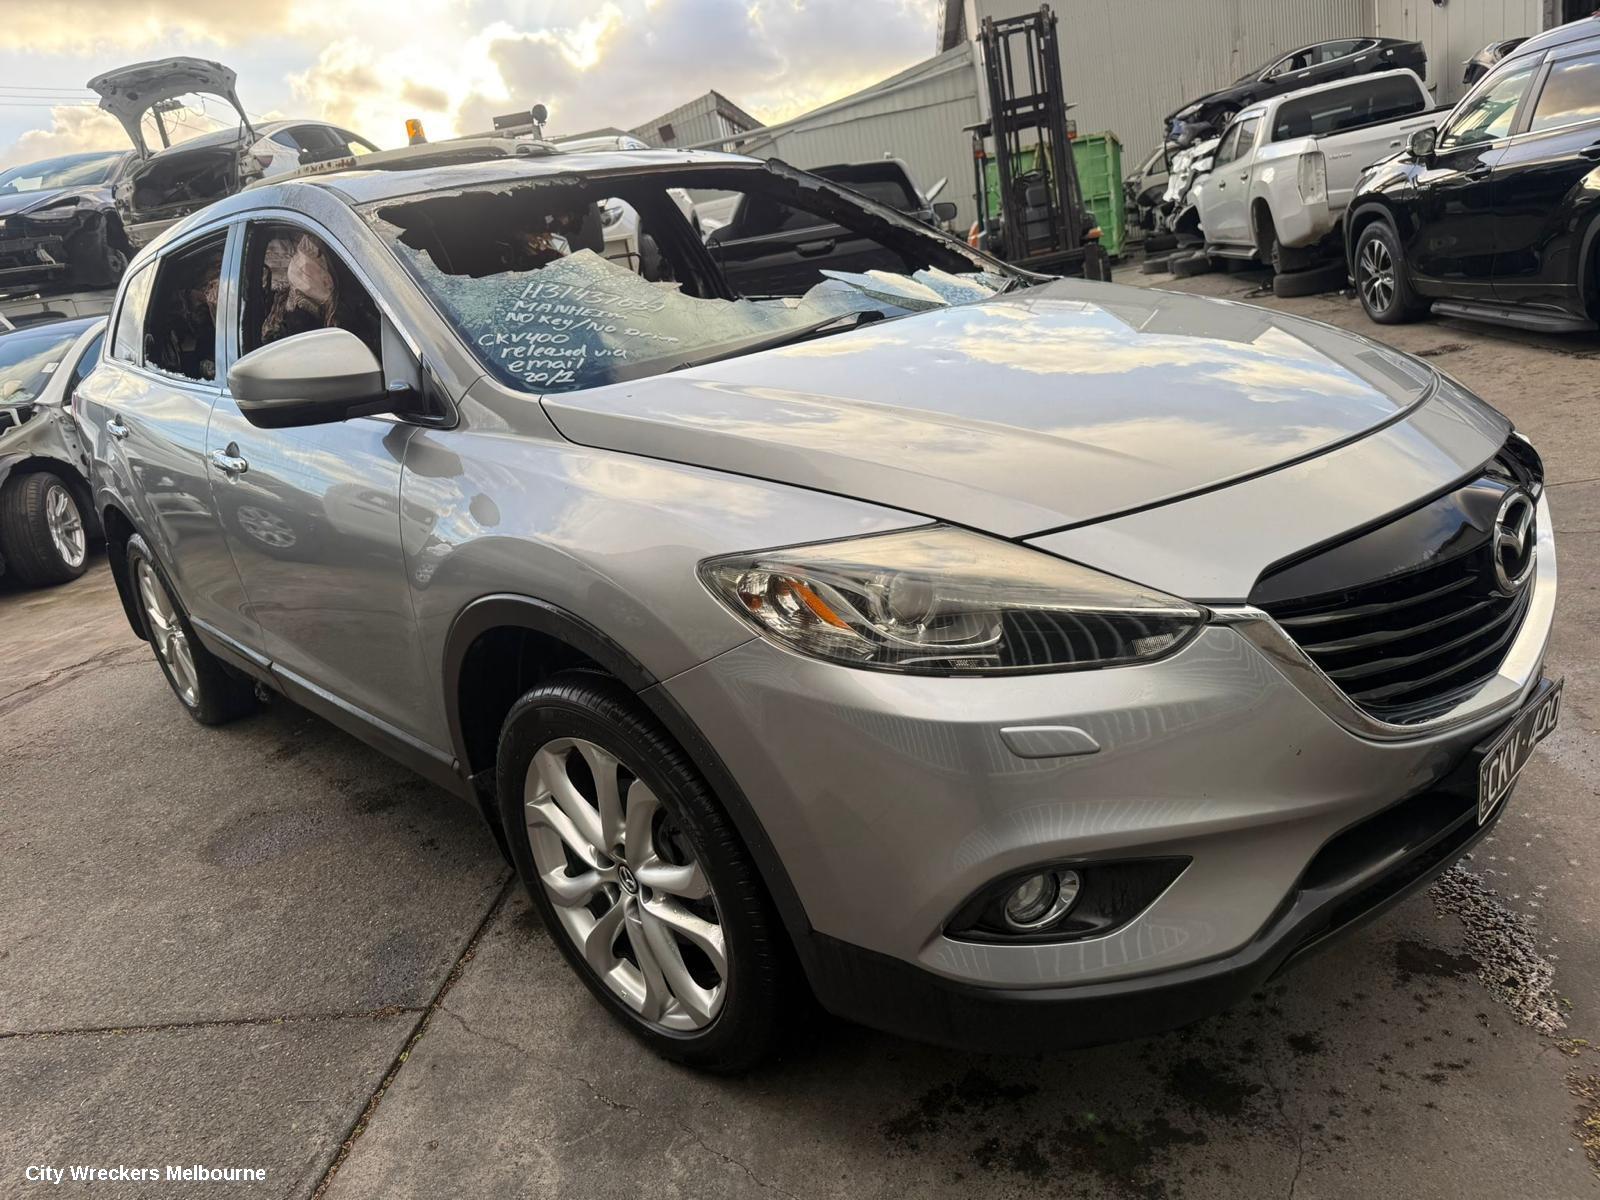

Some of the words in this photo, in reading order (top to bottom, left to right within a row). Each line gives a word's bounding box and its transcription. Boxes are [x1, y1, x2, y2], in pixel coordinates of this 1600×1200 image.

[504, 312, 534, 323] NO
[478, 332, 570, 346] CKV400
[501, 345, 587, 358] released
[594, 348, 627, 359] via
[508, 358, 584, 372] email
